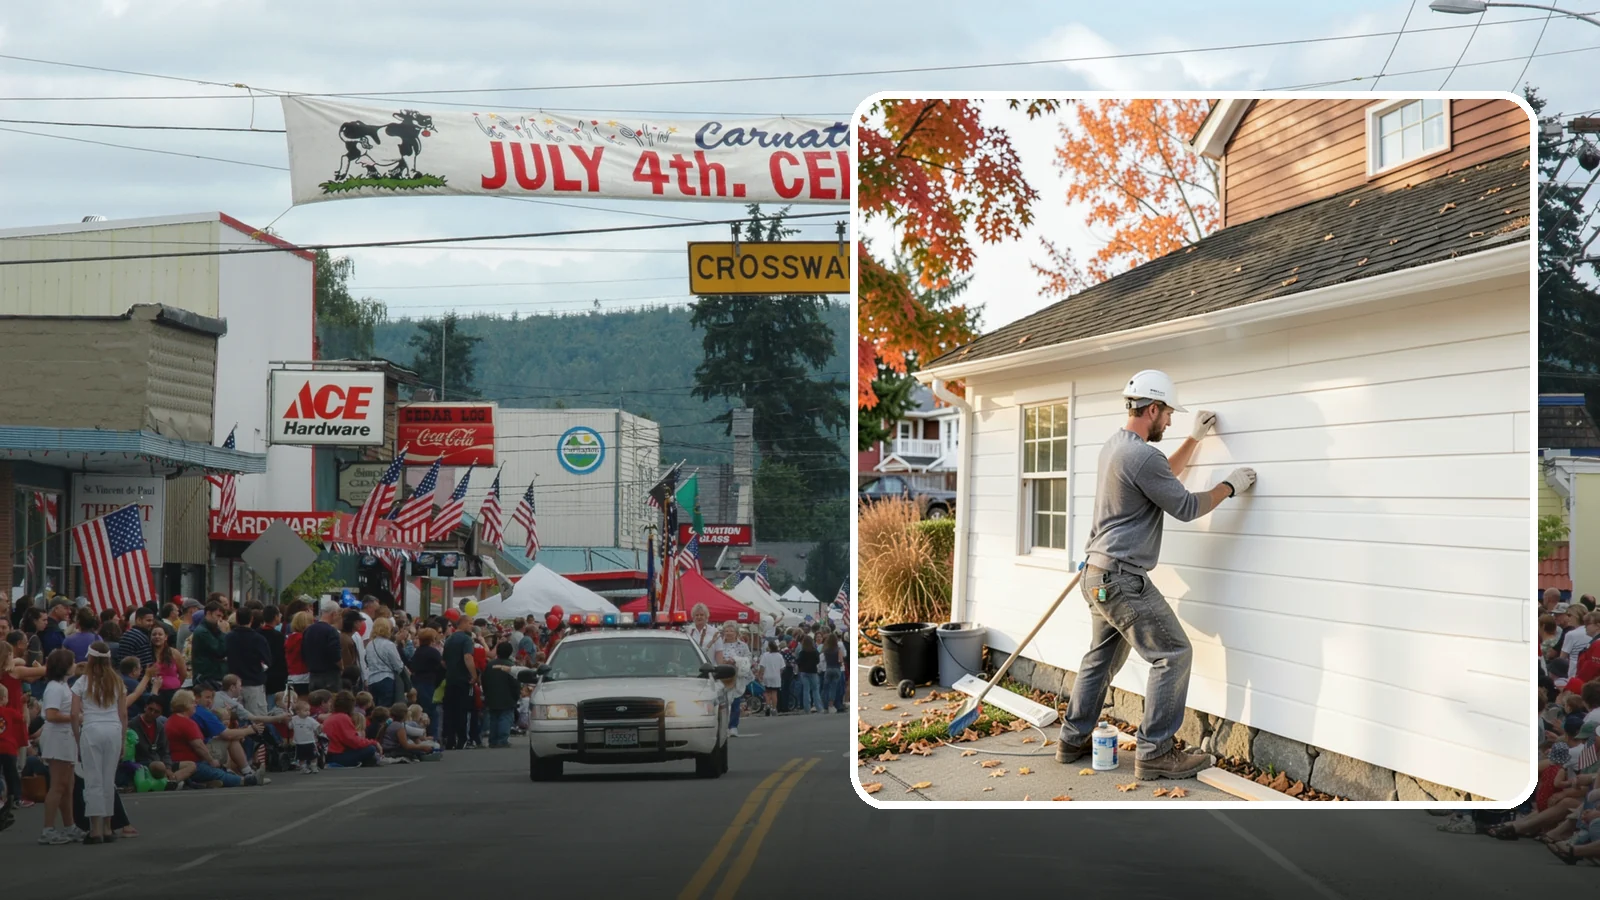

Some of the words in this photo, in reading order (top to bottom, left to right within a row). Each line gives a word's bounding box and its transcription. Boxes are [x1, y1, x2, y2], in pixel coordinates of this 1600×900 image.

[481, 141, 605, 191] JULY
[632, 150, 746, 197] 4th.
[697, 254, 850, 280] CROSSWA
[283, 380, 373, 420] ACE
[405, 409, 453, 421] CEDAR
[461, 409, 485, 421] LOG
[284, 421, 371, 436] Hardware
[416, 428, 477, 447] Coca-Cola
[354, 467, 385, 480] Simpl
[95, 485, 124, 494] Vincent
[126, 486, 136, 494] de
[138, 486, 155, 495] Paul
[688, 526, 741, 534] CRNATION
[699, 535, 730, 543] GLASS
